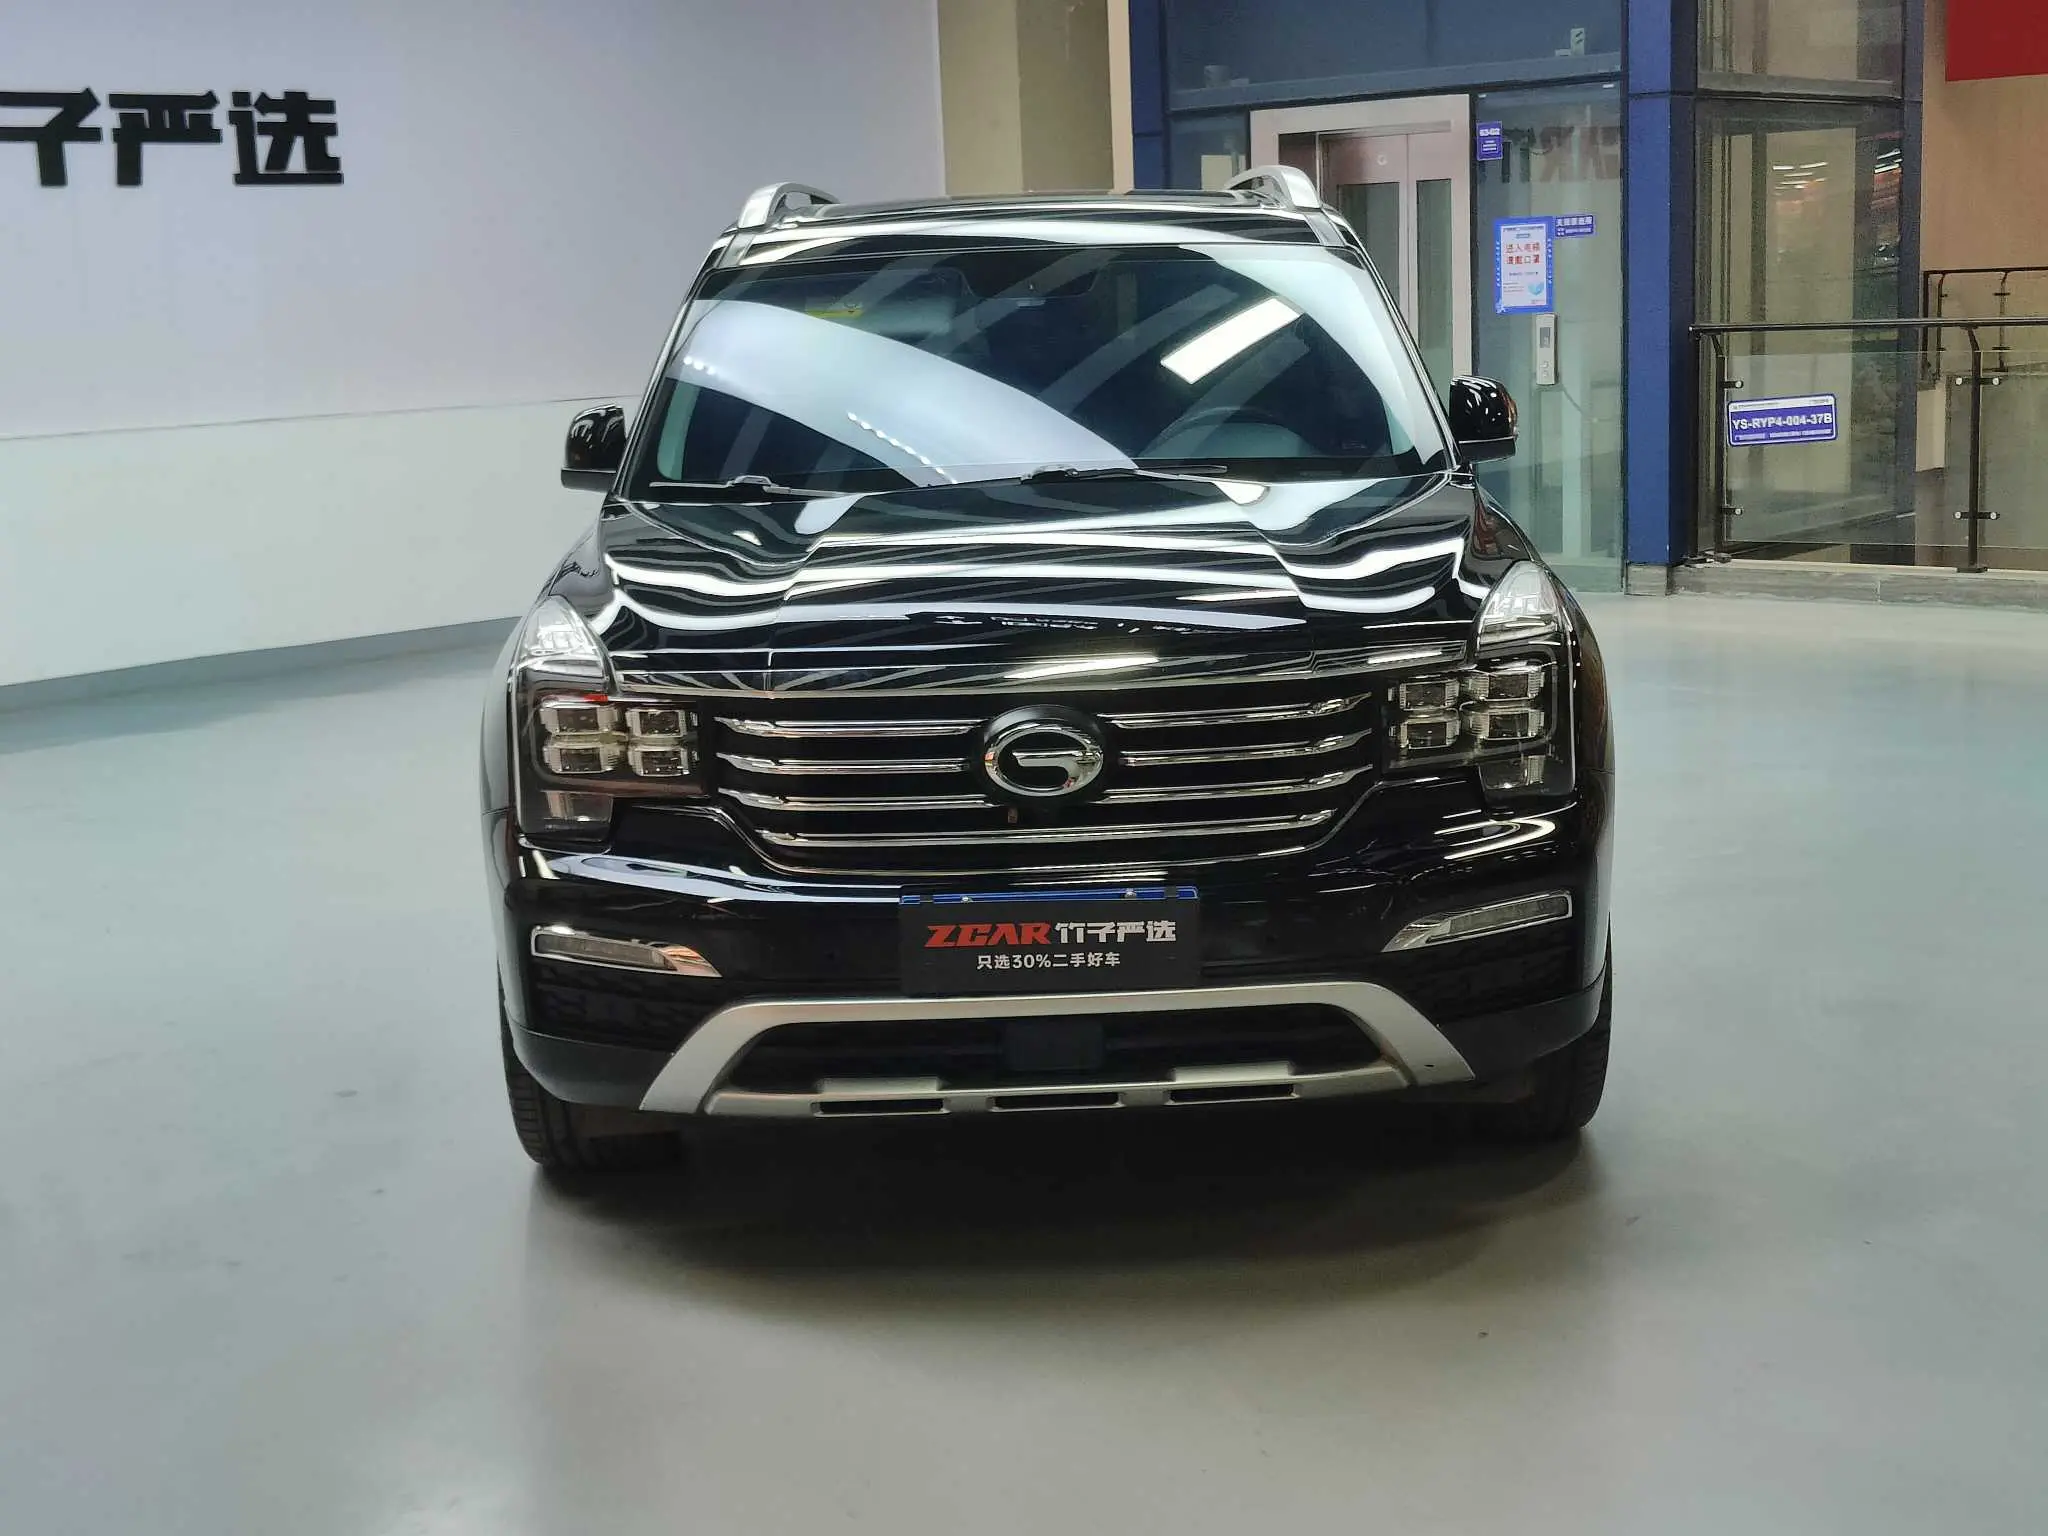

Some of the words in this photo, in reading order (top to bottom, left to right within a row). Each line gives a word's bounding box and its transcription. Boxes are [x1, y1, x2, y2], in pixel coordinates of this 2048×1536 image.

[0, 87, 344, 186] 子严选
[924, 921, 1051, 948] ZCAR
[1055, 920, 1176, 944] 竹子严选
[976, 951, 1121, 970] 只选30%二手好车
